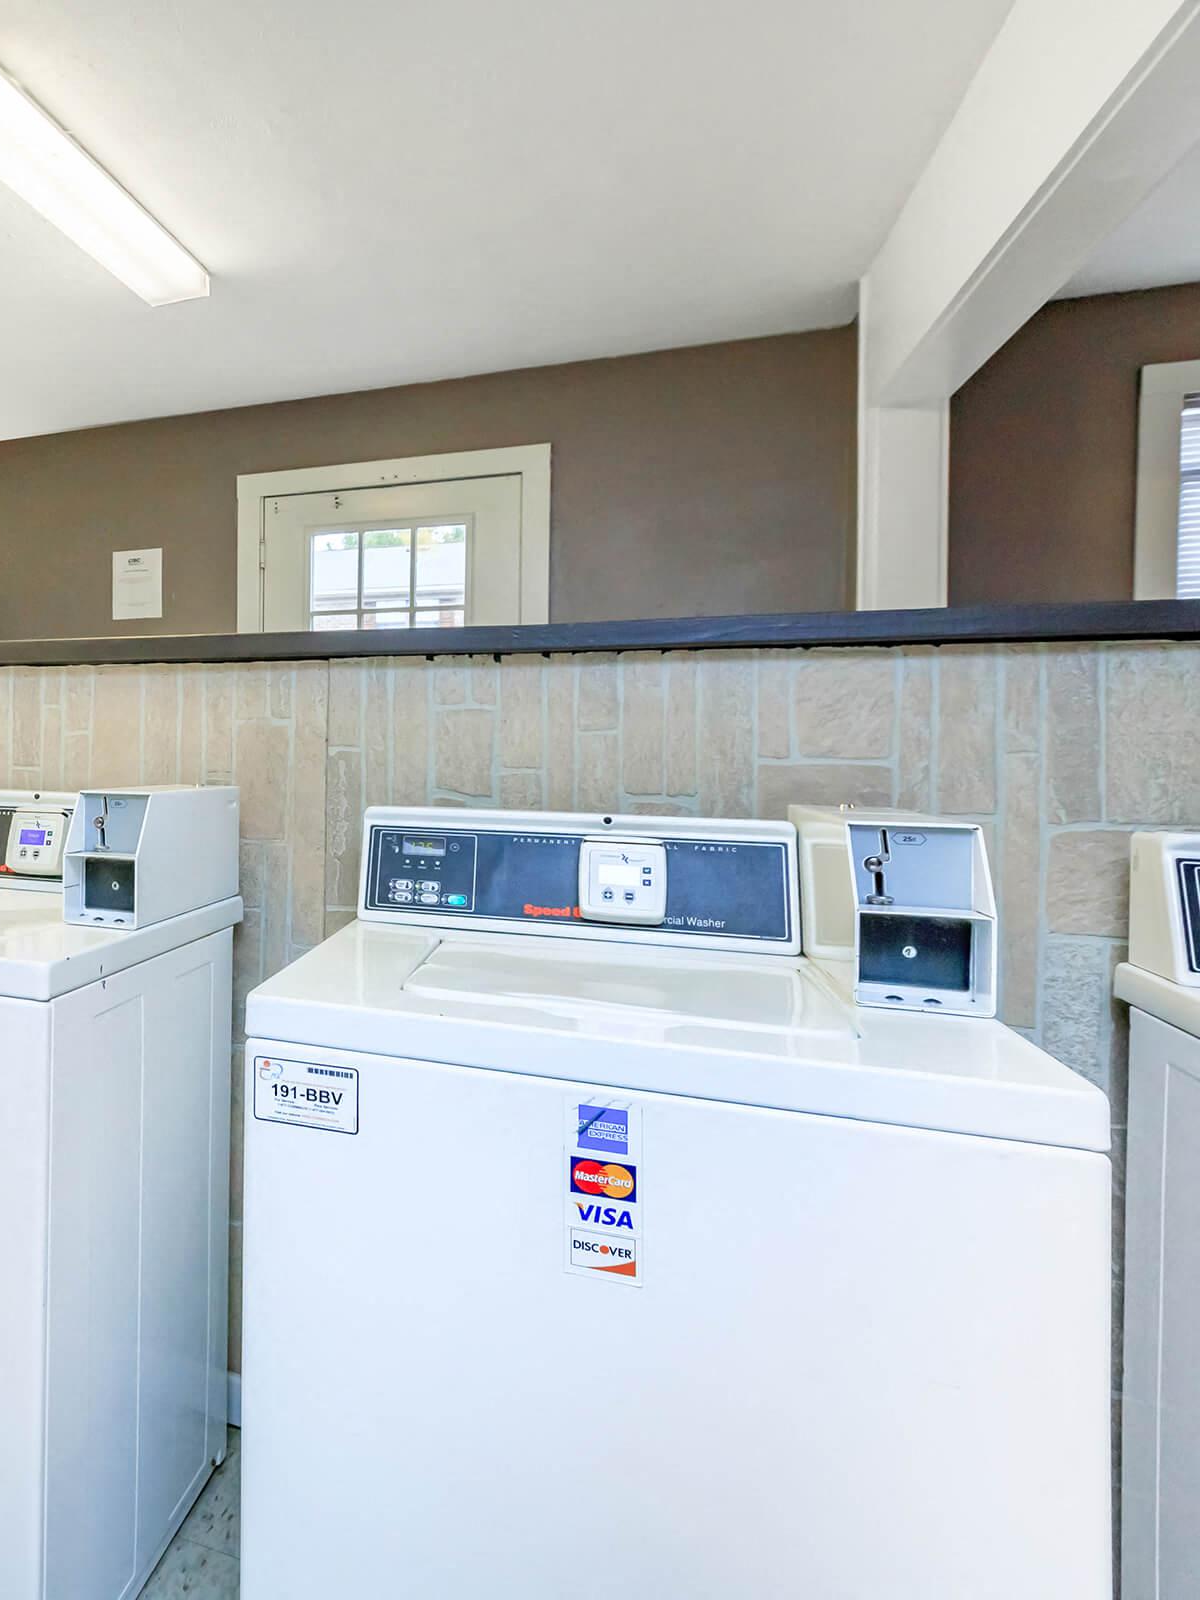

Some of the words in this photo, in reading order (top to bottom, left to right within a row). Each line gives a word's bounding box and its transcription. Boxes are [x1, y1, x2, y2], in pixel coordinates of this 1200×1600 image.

[512, 837, 576, 845] PERMANENT
[523, 903, 570, 917] Speed
[686, 916, 726, 928] Washer
[271, 1083, 343, 1106] 191-BBV
[574, 1170, 632, 1189] MasterCard
[576, 1203, 634, 1230] VISA
[573, 1239, 632, 1260] DISCOVER
